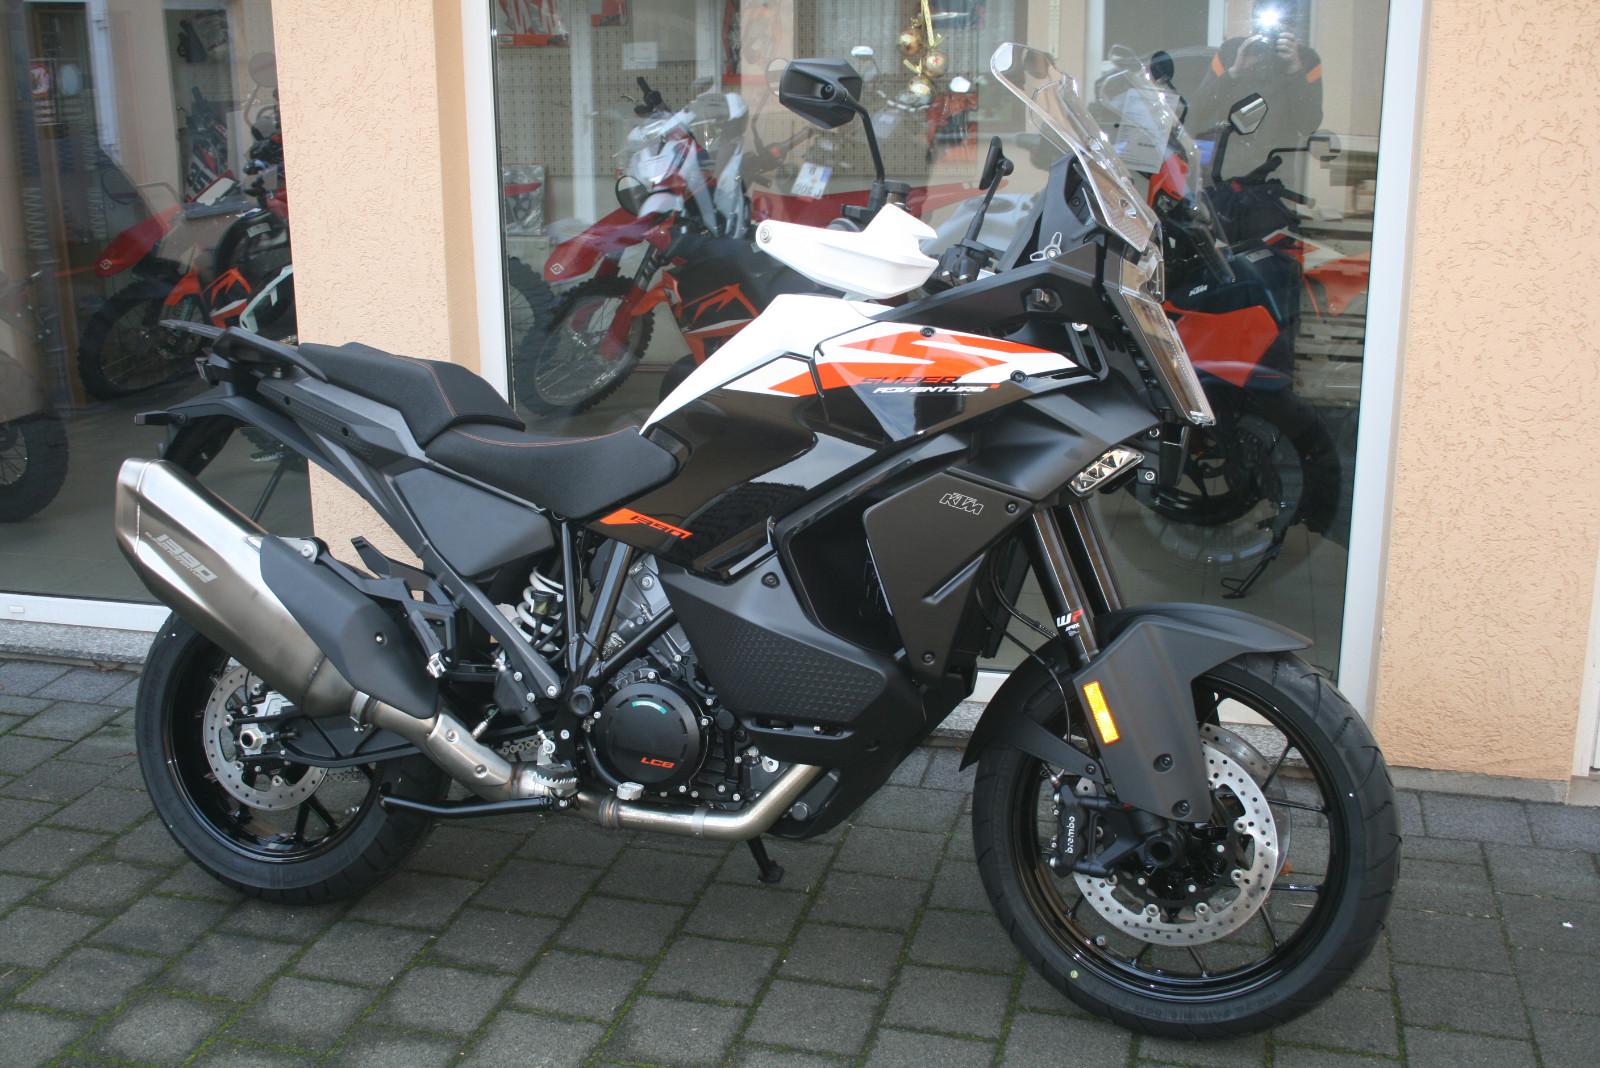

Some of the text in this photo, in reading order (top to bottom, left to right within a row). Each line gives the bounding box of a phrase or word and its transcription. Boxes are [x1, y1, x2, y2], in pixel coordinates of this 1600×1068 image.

[872, 386, 988, 394] ADVENTURE
[939, 493, 984, 515] KTM
[1056, 609, 1084, 628] WP
[1065, 816, 1076, 854] brembo
